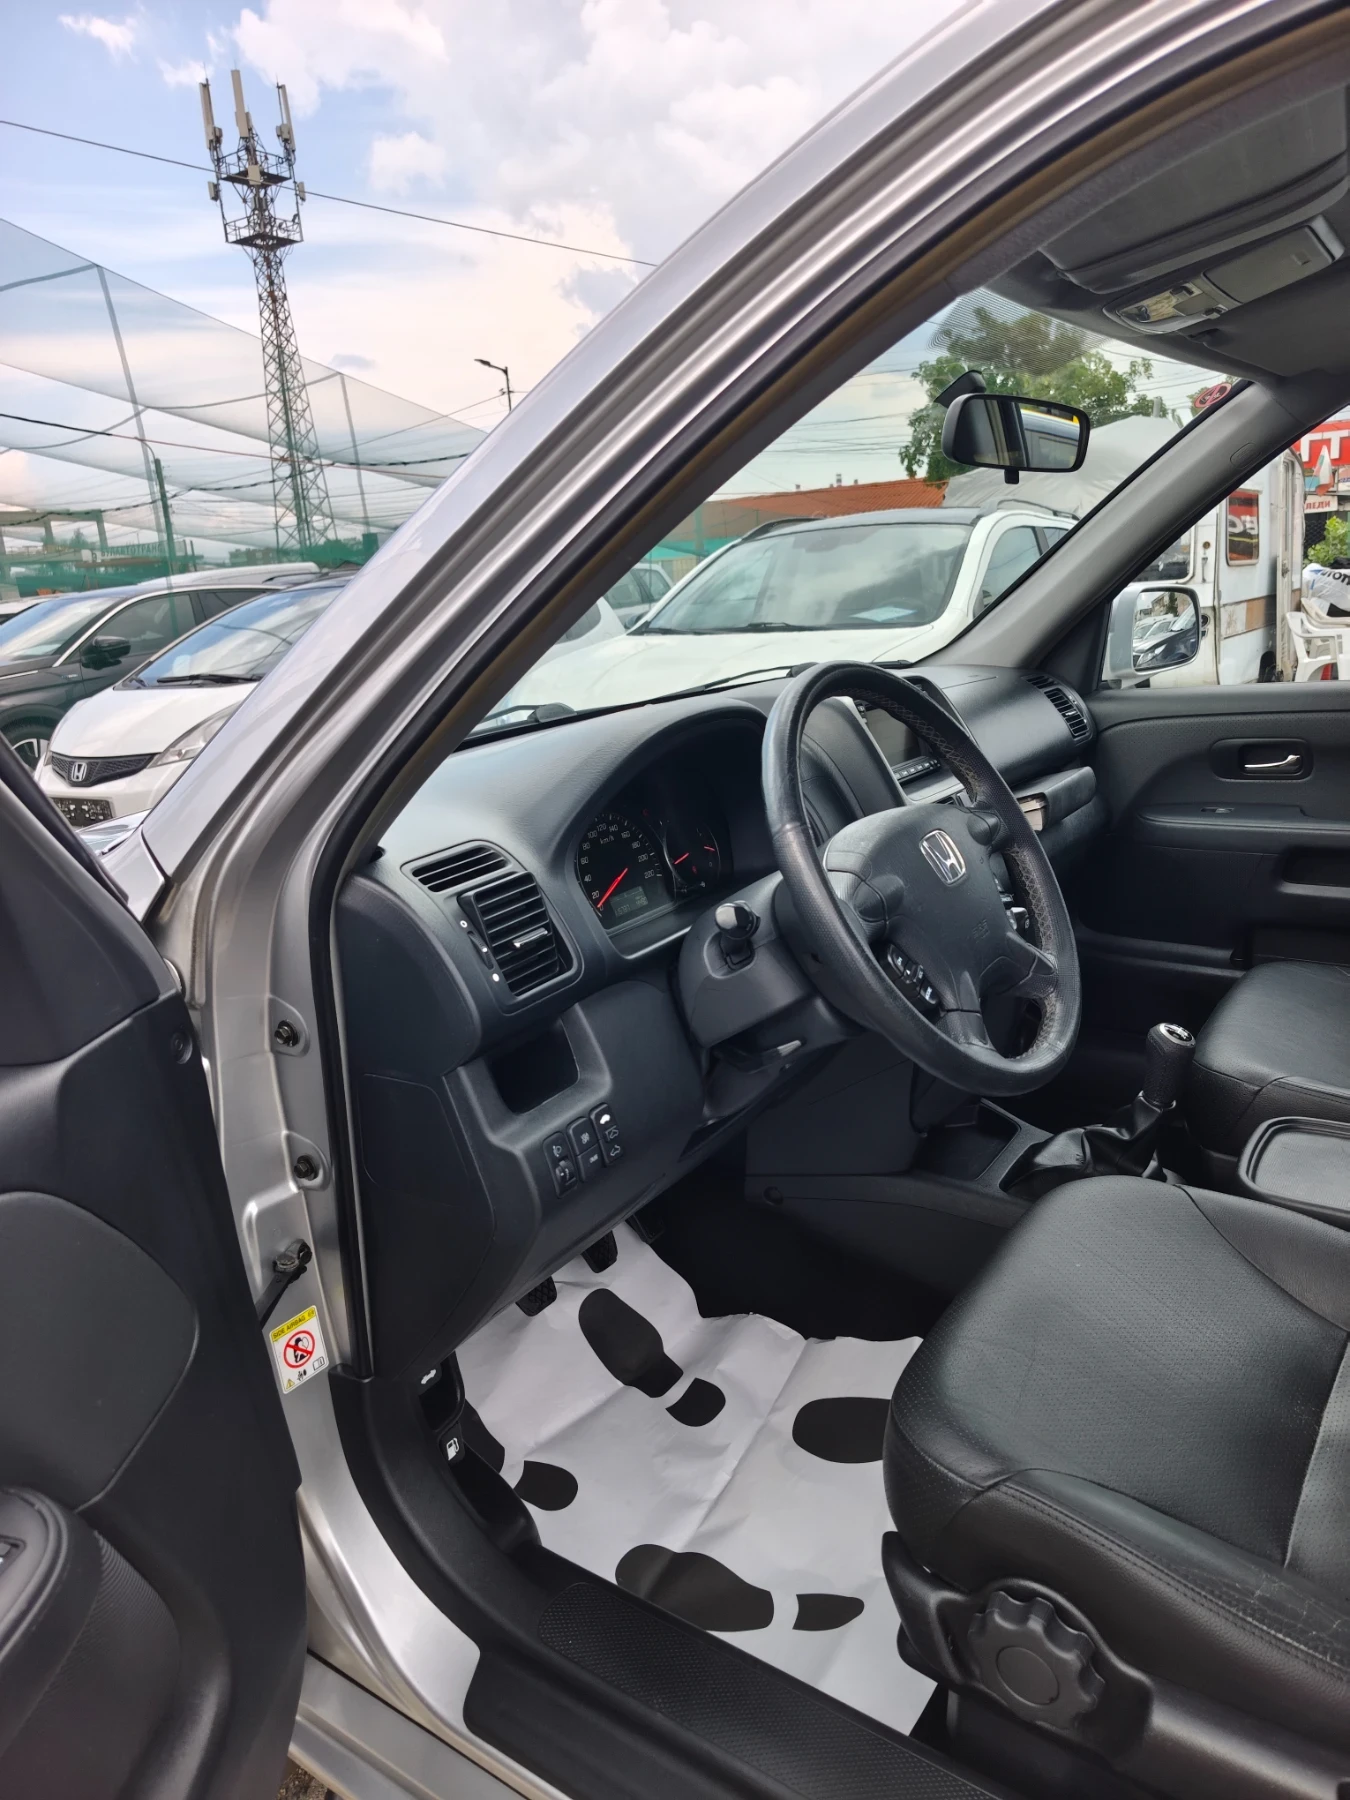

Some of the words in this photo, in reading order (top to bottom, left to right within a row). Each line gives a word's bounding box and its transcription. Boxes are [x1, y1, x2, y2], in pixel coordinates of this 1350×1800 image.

[597, 823, 606, 832] 120
[609, 824, 618, 832] 140
[587, 830, 597, 839] 100
[599, 835, 615, 844] km/h
[582, 842, 591, 850] 80
[638, 853, 648, 862] 200
[584, 874, 592, 882] 40
[644, 869, 655, 879] 220
[592, 890, 600, 899] 20
[286, 1315, 306, 1332] AIRBAG
